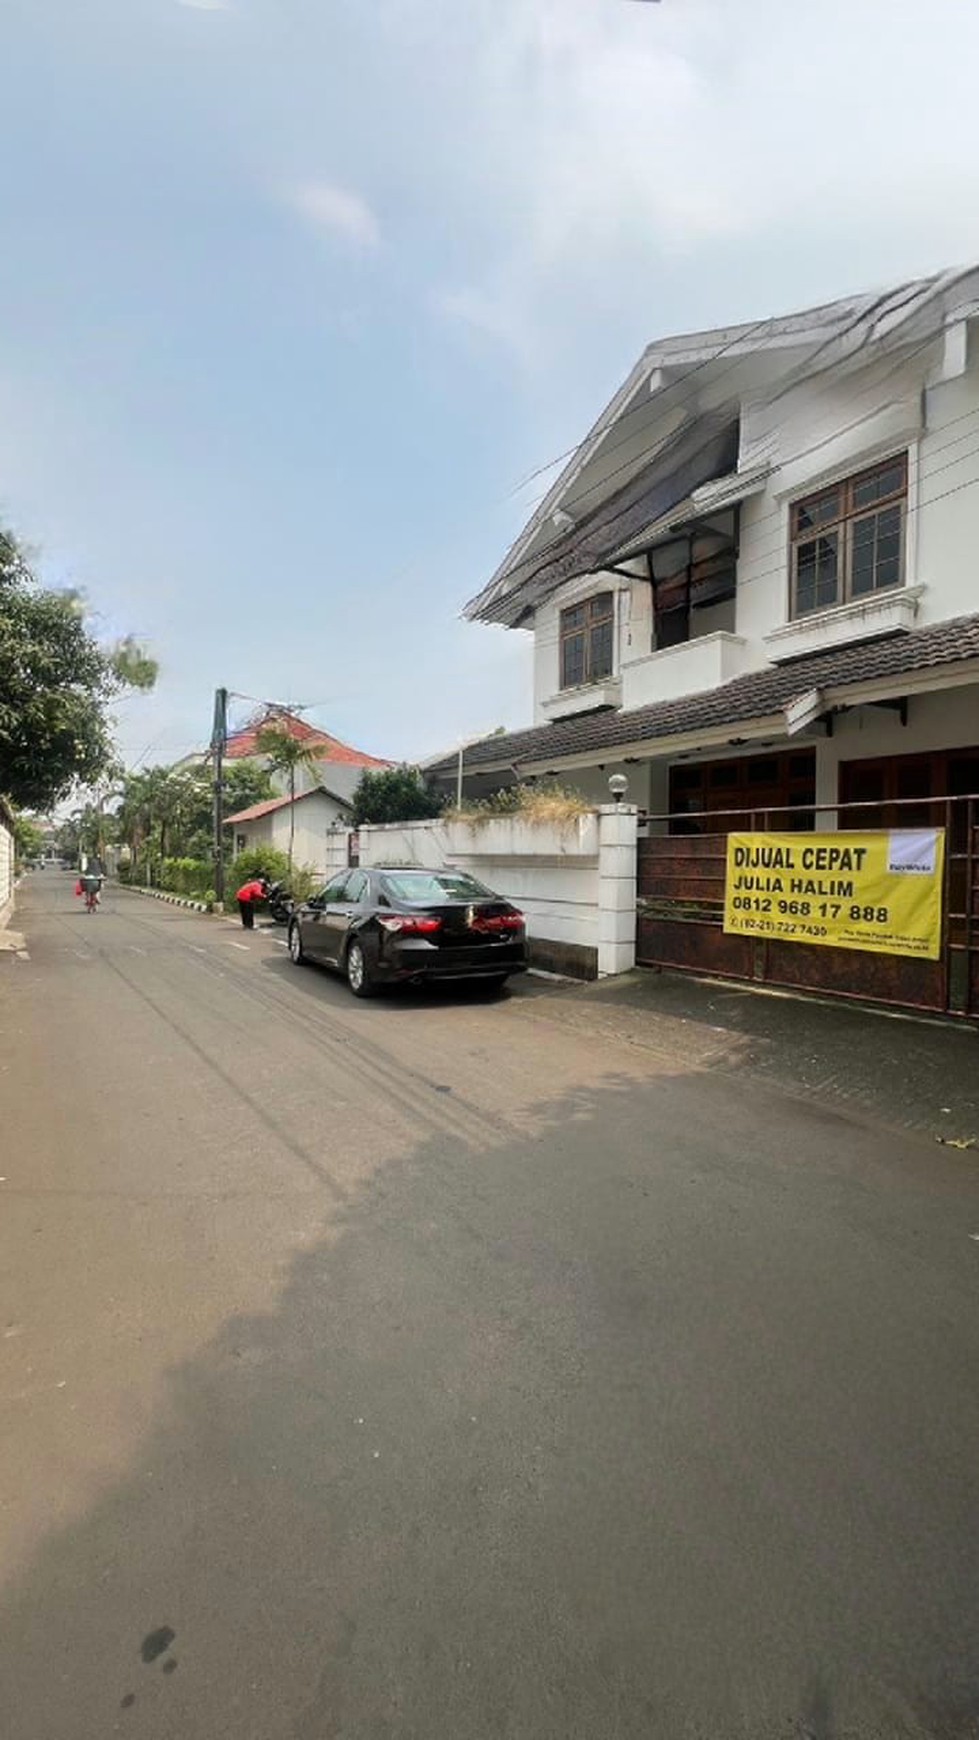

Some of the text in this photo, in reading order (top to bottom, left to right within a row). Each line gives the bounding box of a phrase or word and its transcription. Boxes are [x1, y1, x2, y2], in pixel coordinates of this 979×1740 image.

[734, 847, 867, 871] DIJUAL CEPAT
[733, 876, 853, 897] JULIA HALIM
[732, 896, 889, 923] 0812 968 17 888
